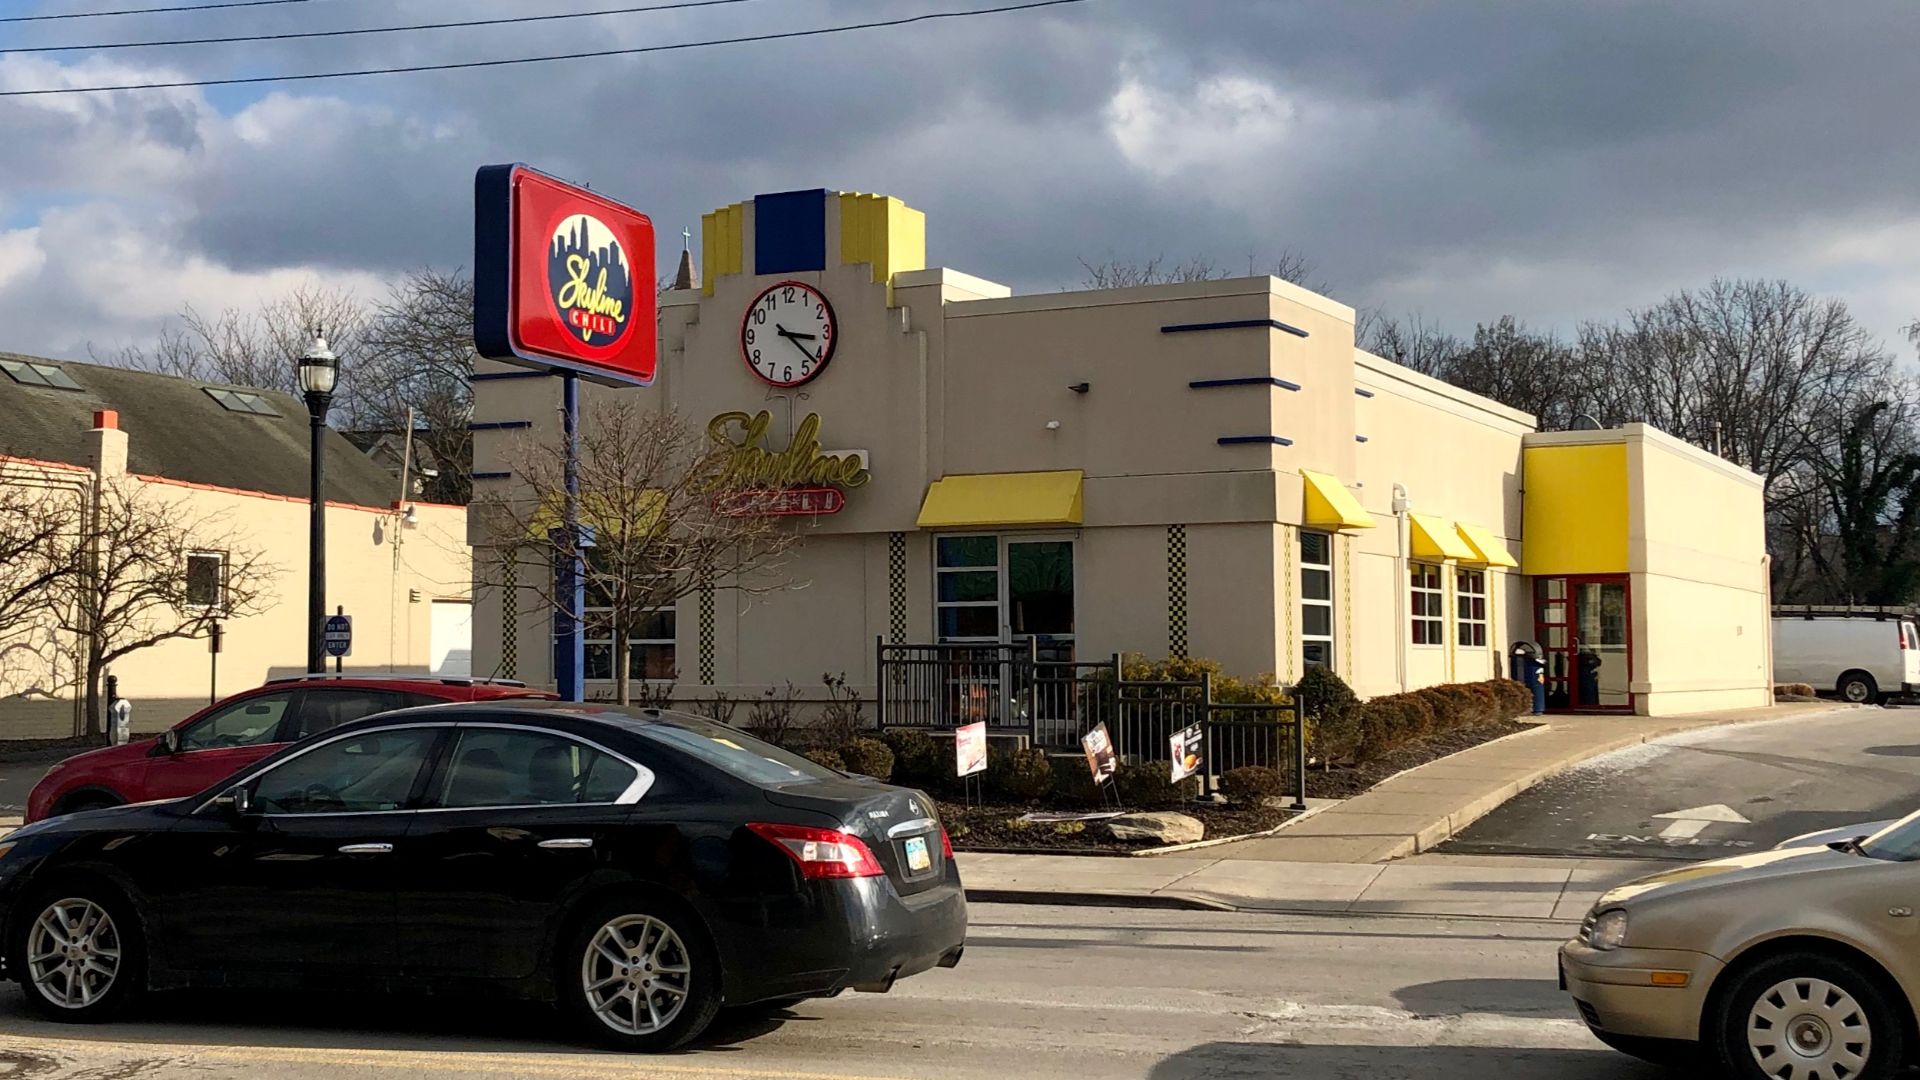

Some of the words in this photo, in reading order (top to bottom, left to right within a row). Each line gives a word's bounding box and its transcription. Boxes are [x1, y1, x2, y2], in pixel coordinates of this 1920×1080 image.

[558, 254, 625, 341] Skyline
[765, 294, 776, 311] 11
[781, 287, 795, 304] 12
[802, 290, 808, 307] 1
[752, 308, 766, 325] 10
[815, 303, 824, 320] 2
[573, 310, 613, 334] CHILI
[746, 329, 755, 345] 9
[822, 324, 830, 340] 3
[752, 349, 761, 365] 8
[815, 345, 823, 361] 4
[768, 362, 776, 379] 7
[783, 366, 792, 382] 6
[801, 360, 810, 376] 5
[686, 410, 871, 496] Skyline
[327, 623, 335, 631] DO
[336, 623, 348, 631] NOT
[328, 641, 347, 649] ENTER
